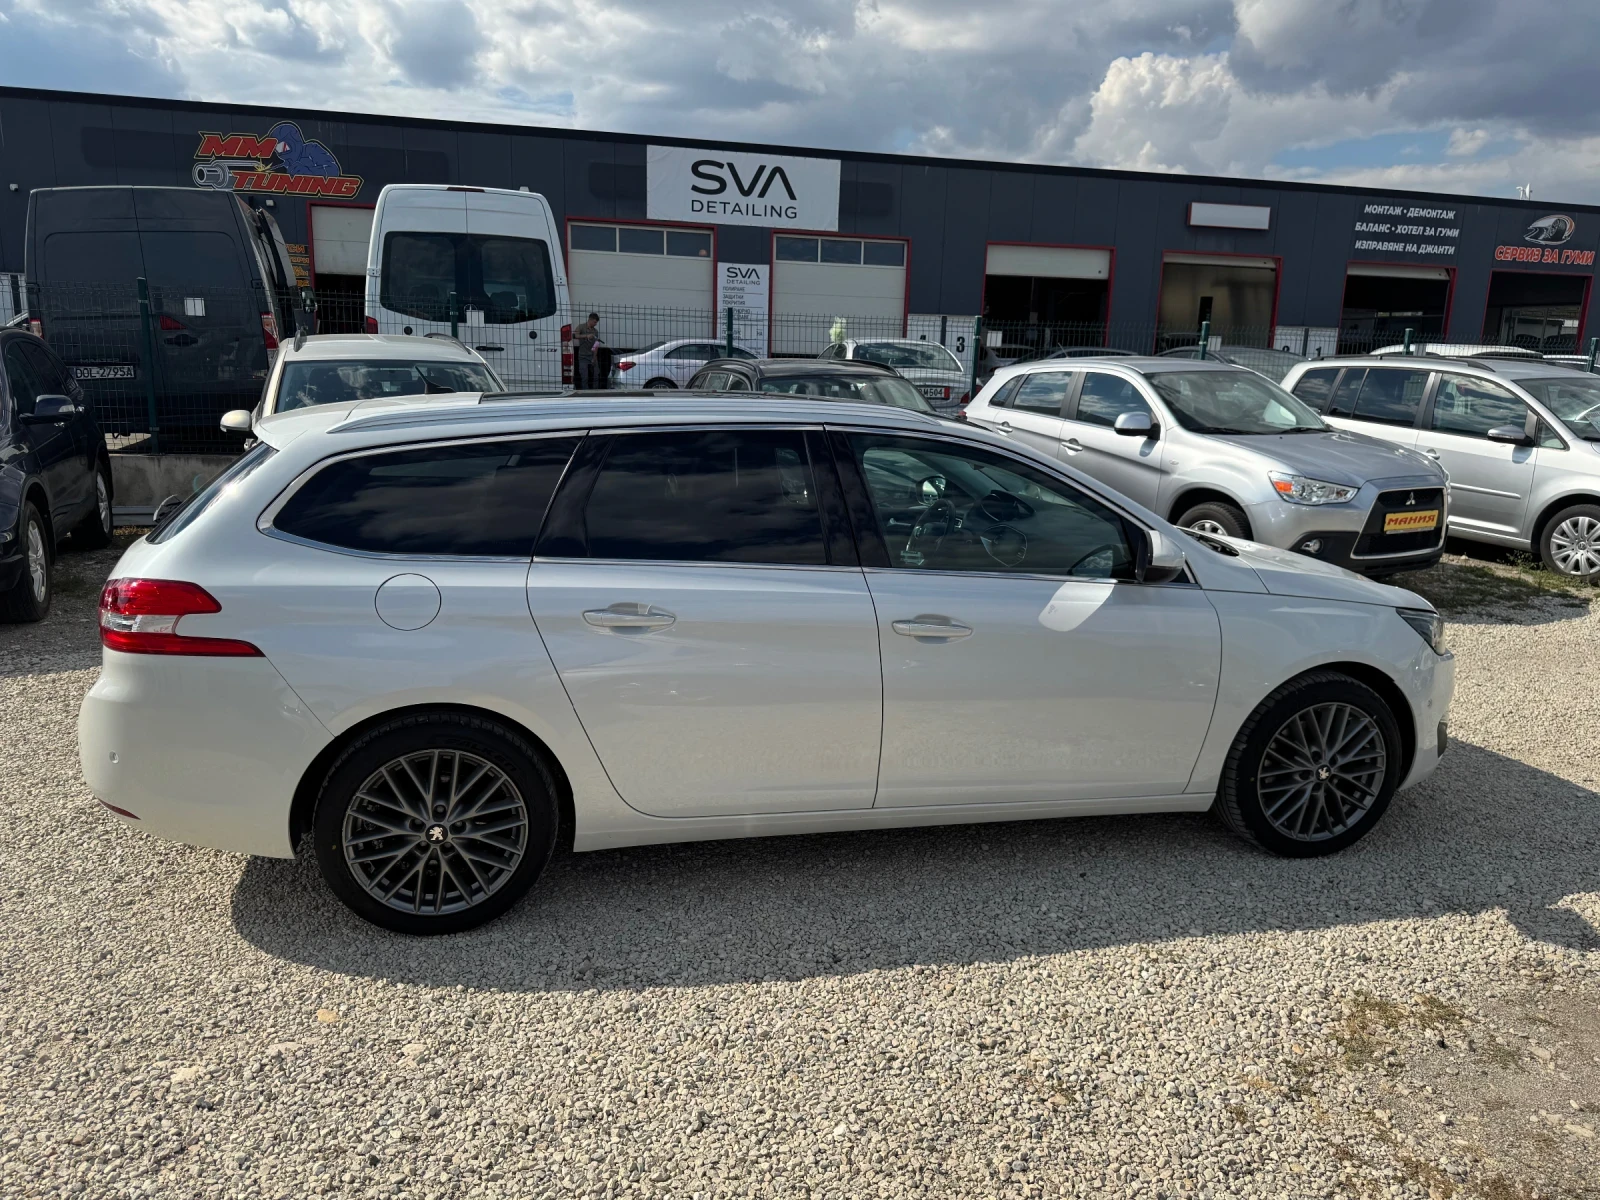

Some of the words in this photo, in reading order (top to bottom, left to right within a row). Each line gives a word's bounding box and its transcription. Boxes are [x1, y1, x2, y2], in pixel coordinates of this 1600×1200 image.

[199, 134, 278, 159] MM
[231, 171, 361, 196] TUNING
[691, 159, 797, 201] SVA
[691, 200, 797, 219] DETAILING
[1364, 204, 1404, 216] МОНТАЖ
[1406, 207, 1456, 220] ДЕМОНТАЖ
[1354, 221, 1391, 233] БАЛАНС
[1395, 224, 1424, 236] ХОТЕЛ
[1424, 226, 1435, 236] ЗА
[1435, 227, 1460, 238] ГУМИ
[1354, 239, 1405, 252] ИЗПРАВЯНЕ
[1404, 242, 1417, 253] НА
[1417, 243, 1456, 255] ДЖАНТИ
[1494, 245, 1543, 263] СЕРВИЗ
[1542, 248, 1559, 264] ЗА
[1560, 249, 1596, 265] ГУМИ
[726, 266, 760, 280] SVA
[726, 278, 761, 286] DETAILING
[956, 336, 966, 353] 3
[75, 367, 97, 379] DOL
[99, 366, 133, 378] 2795A
[1386, 514, 1437, 526] МАНИЯ
